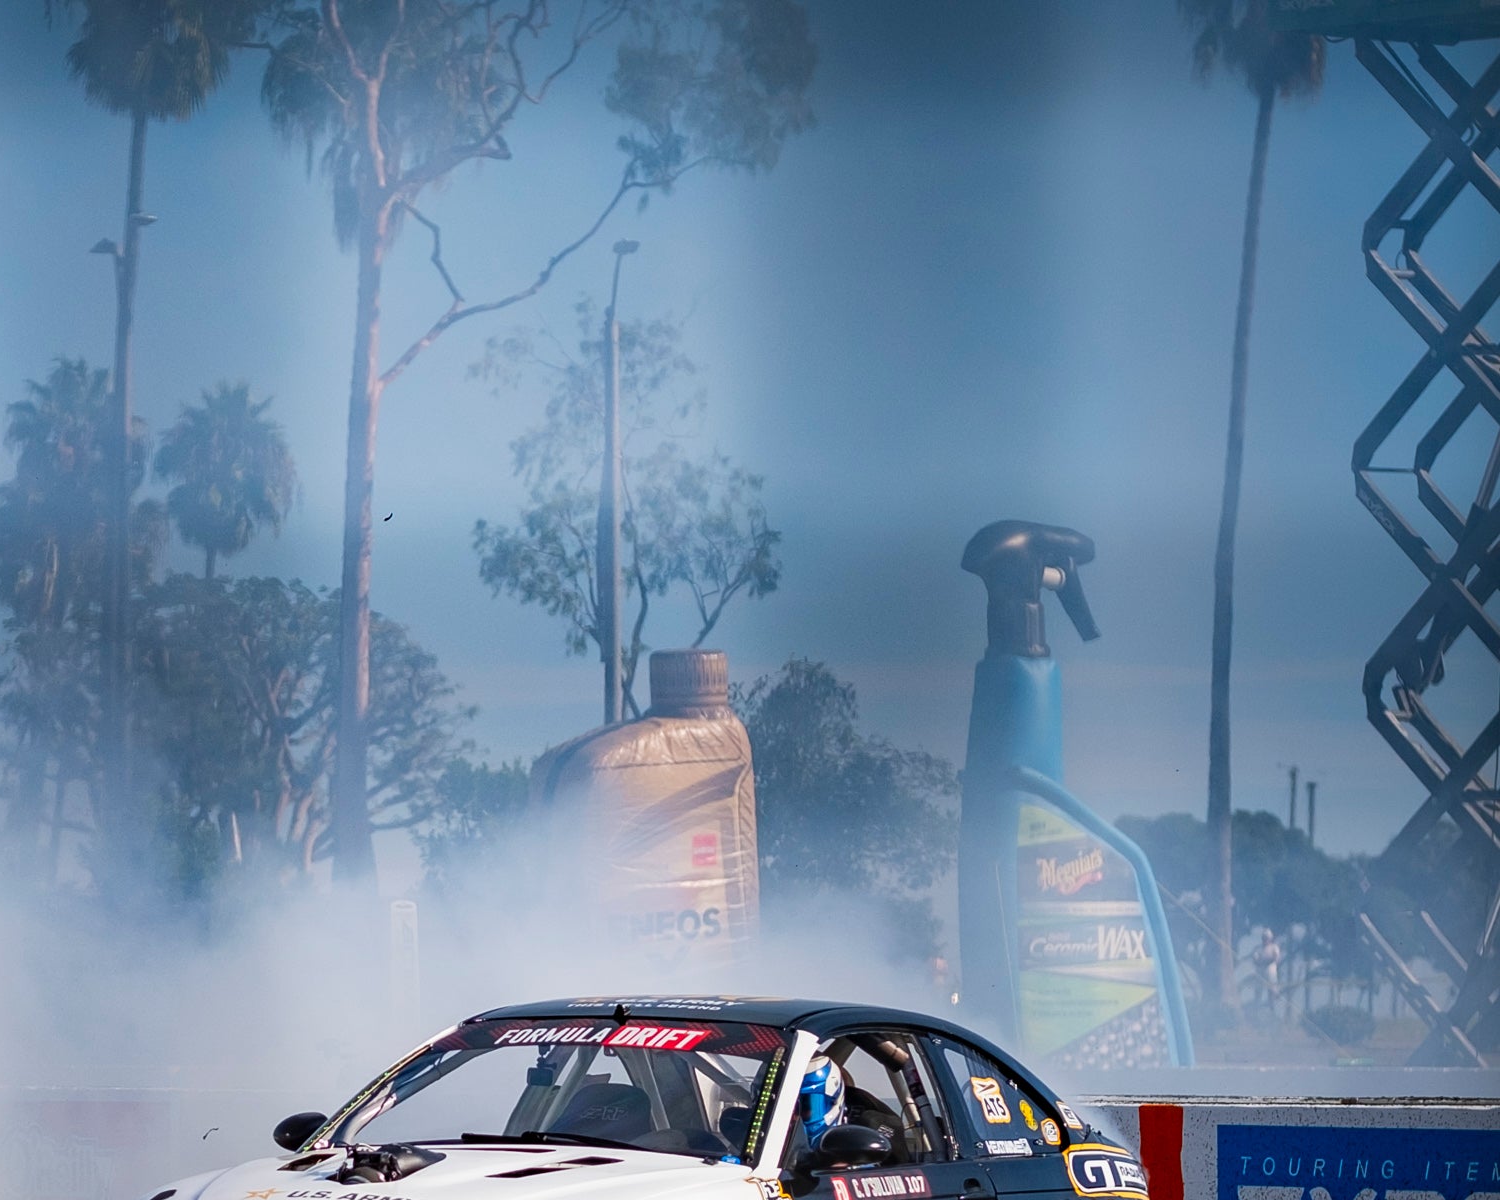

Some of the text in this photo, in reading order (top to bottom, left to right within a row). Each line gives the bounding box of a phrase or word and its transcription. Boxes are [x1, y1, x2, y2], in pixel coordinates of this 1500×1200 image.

[1097, 924, 1150, 961] WAX
[656, 1003, 722, 1011] DEFEND
[495, 1027, 705, 1049] FORMULA DRIFT
[984, 1097, 1007, 1117] ATS
[1072, 1154, 1122, 1188] GT
[1240, 1156, 1396, 1179] TOURING
[286, 1190, 333, 1200] U.S.
[861, 1175, 907, 1198] O'SULLIVAN
[905, 1175, 926, 1193] 107
